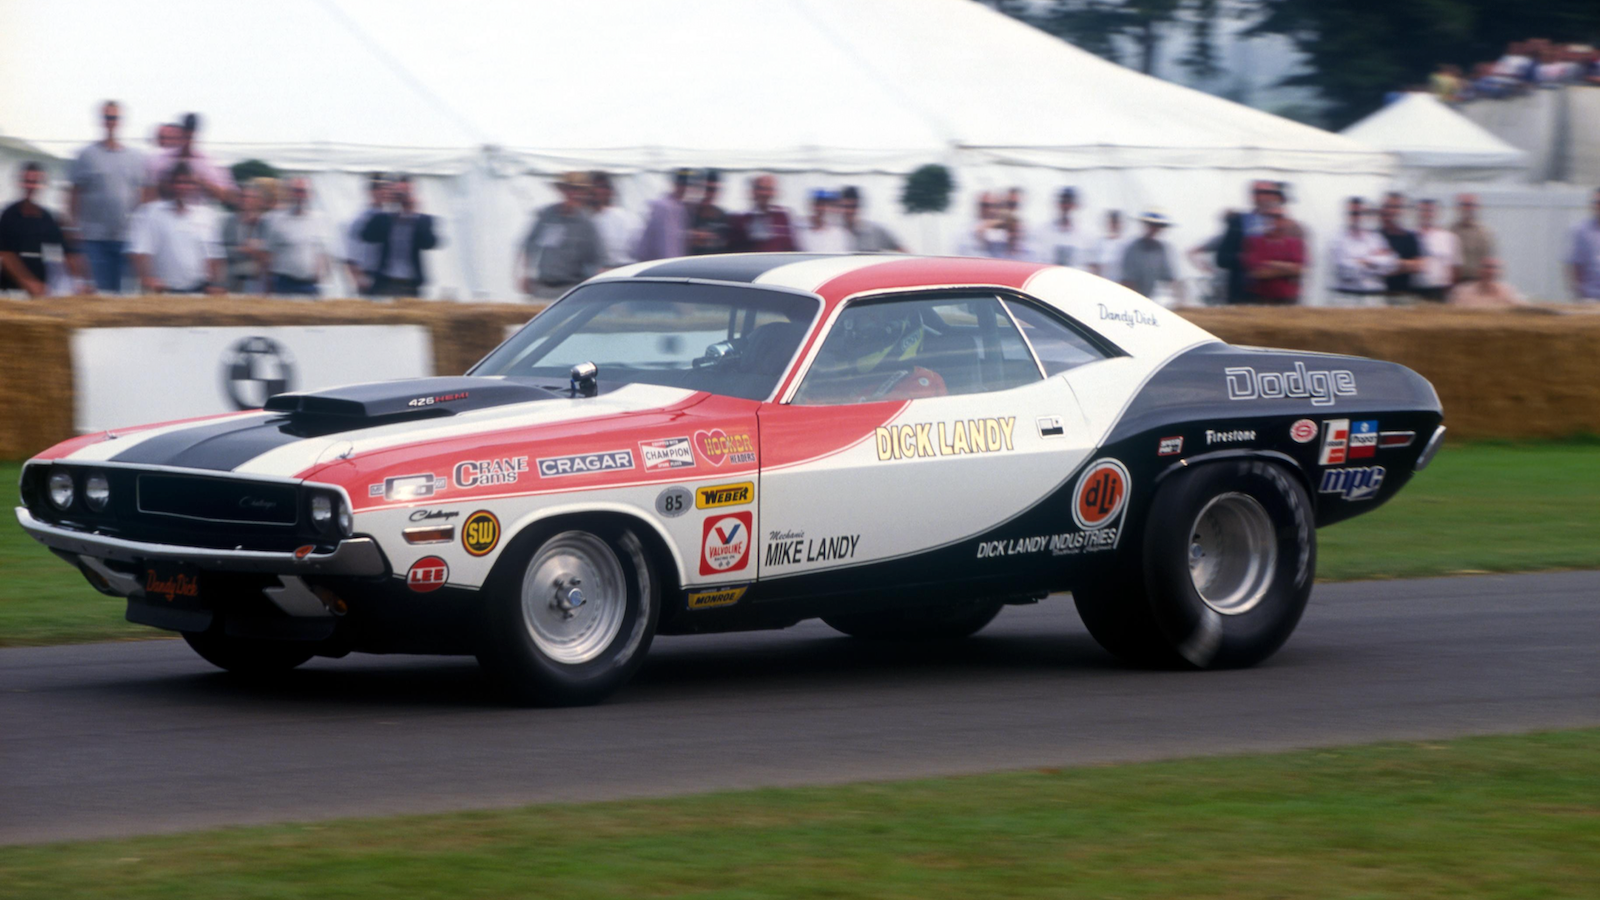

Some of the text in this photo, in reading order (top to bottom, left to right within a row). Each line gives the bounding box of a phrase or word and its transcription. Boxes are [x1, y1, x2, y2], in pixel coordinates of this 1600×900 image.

[1097, 303, 1160, 329] Dandy Dick
[1224, 361, 1357, 406] Dodge
[408, 396, 435, 407] 426
[703, 434, 754, 456] HOOKER
[875, 416, 1016, 461] DICK LANDY
[1205, 429, 1256, 445] Firestone
[645, 446, 690, 461] CHAMPION
[729, 453, 756, 464] HEADERS
[542, 454, 629, 475] CRAGAR
[1318, 466, 1386, 501] mpc
[664, 494, 683, 512] 85
[701, 487, 749, 506] WEBER
[468, 521, 493, 545] SW
[769, 530, 805, 541] Mechanic
[709, 541, 743, 559] VALVOLINE
[765, 534, 860, 567] MIKE LANDY
[977, 540, 1007, 558] DICK
[1008, 535, 1050, 555] LANDY
[1049, 528, 1117, 551] INDUSTRIES
[410, 567, 445, 584] LEE
[695, 592, 736, 605] MONROE
